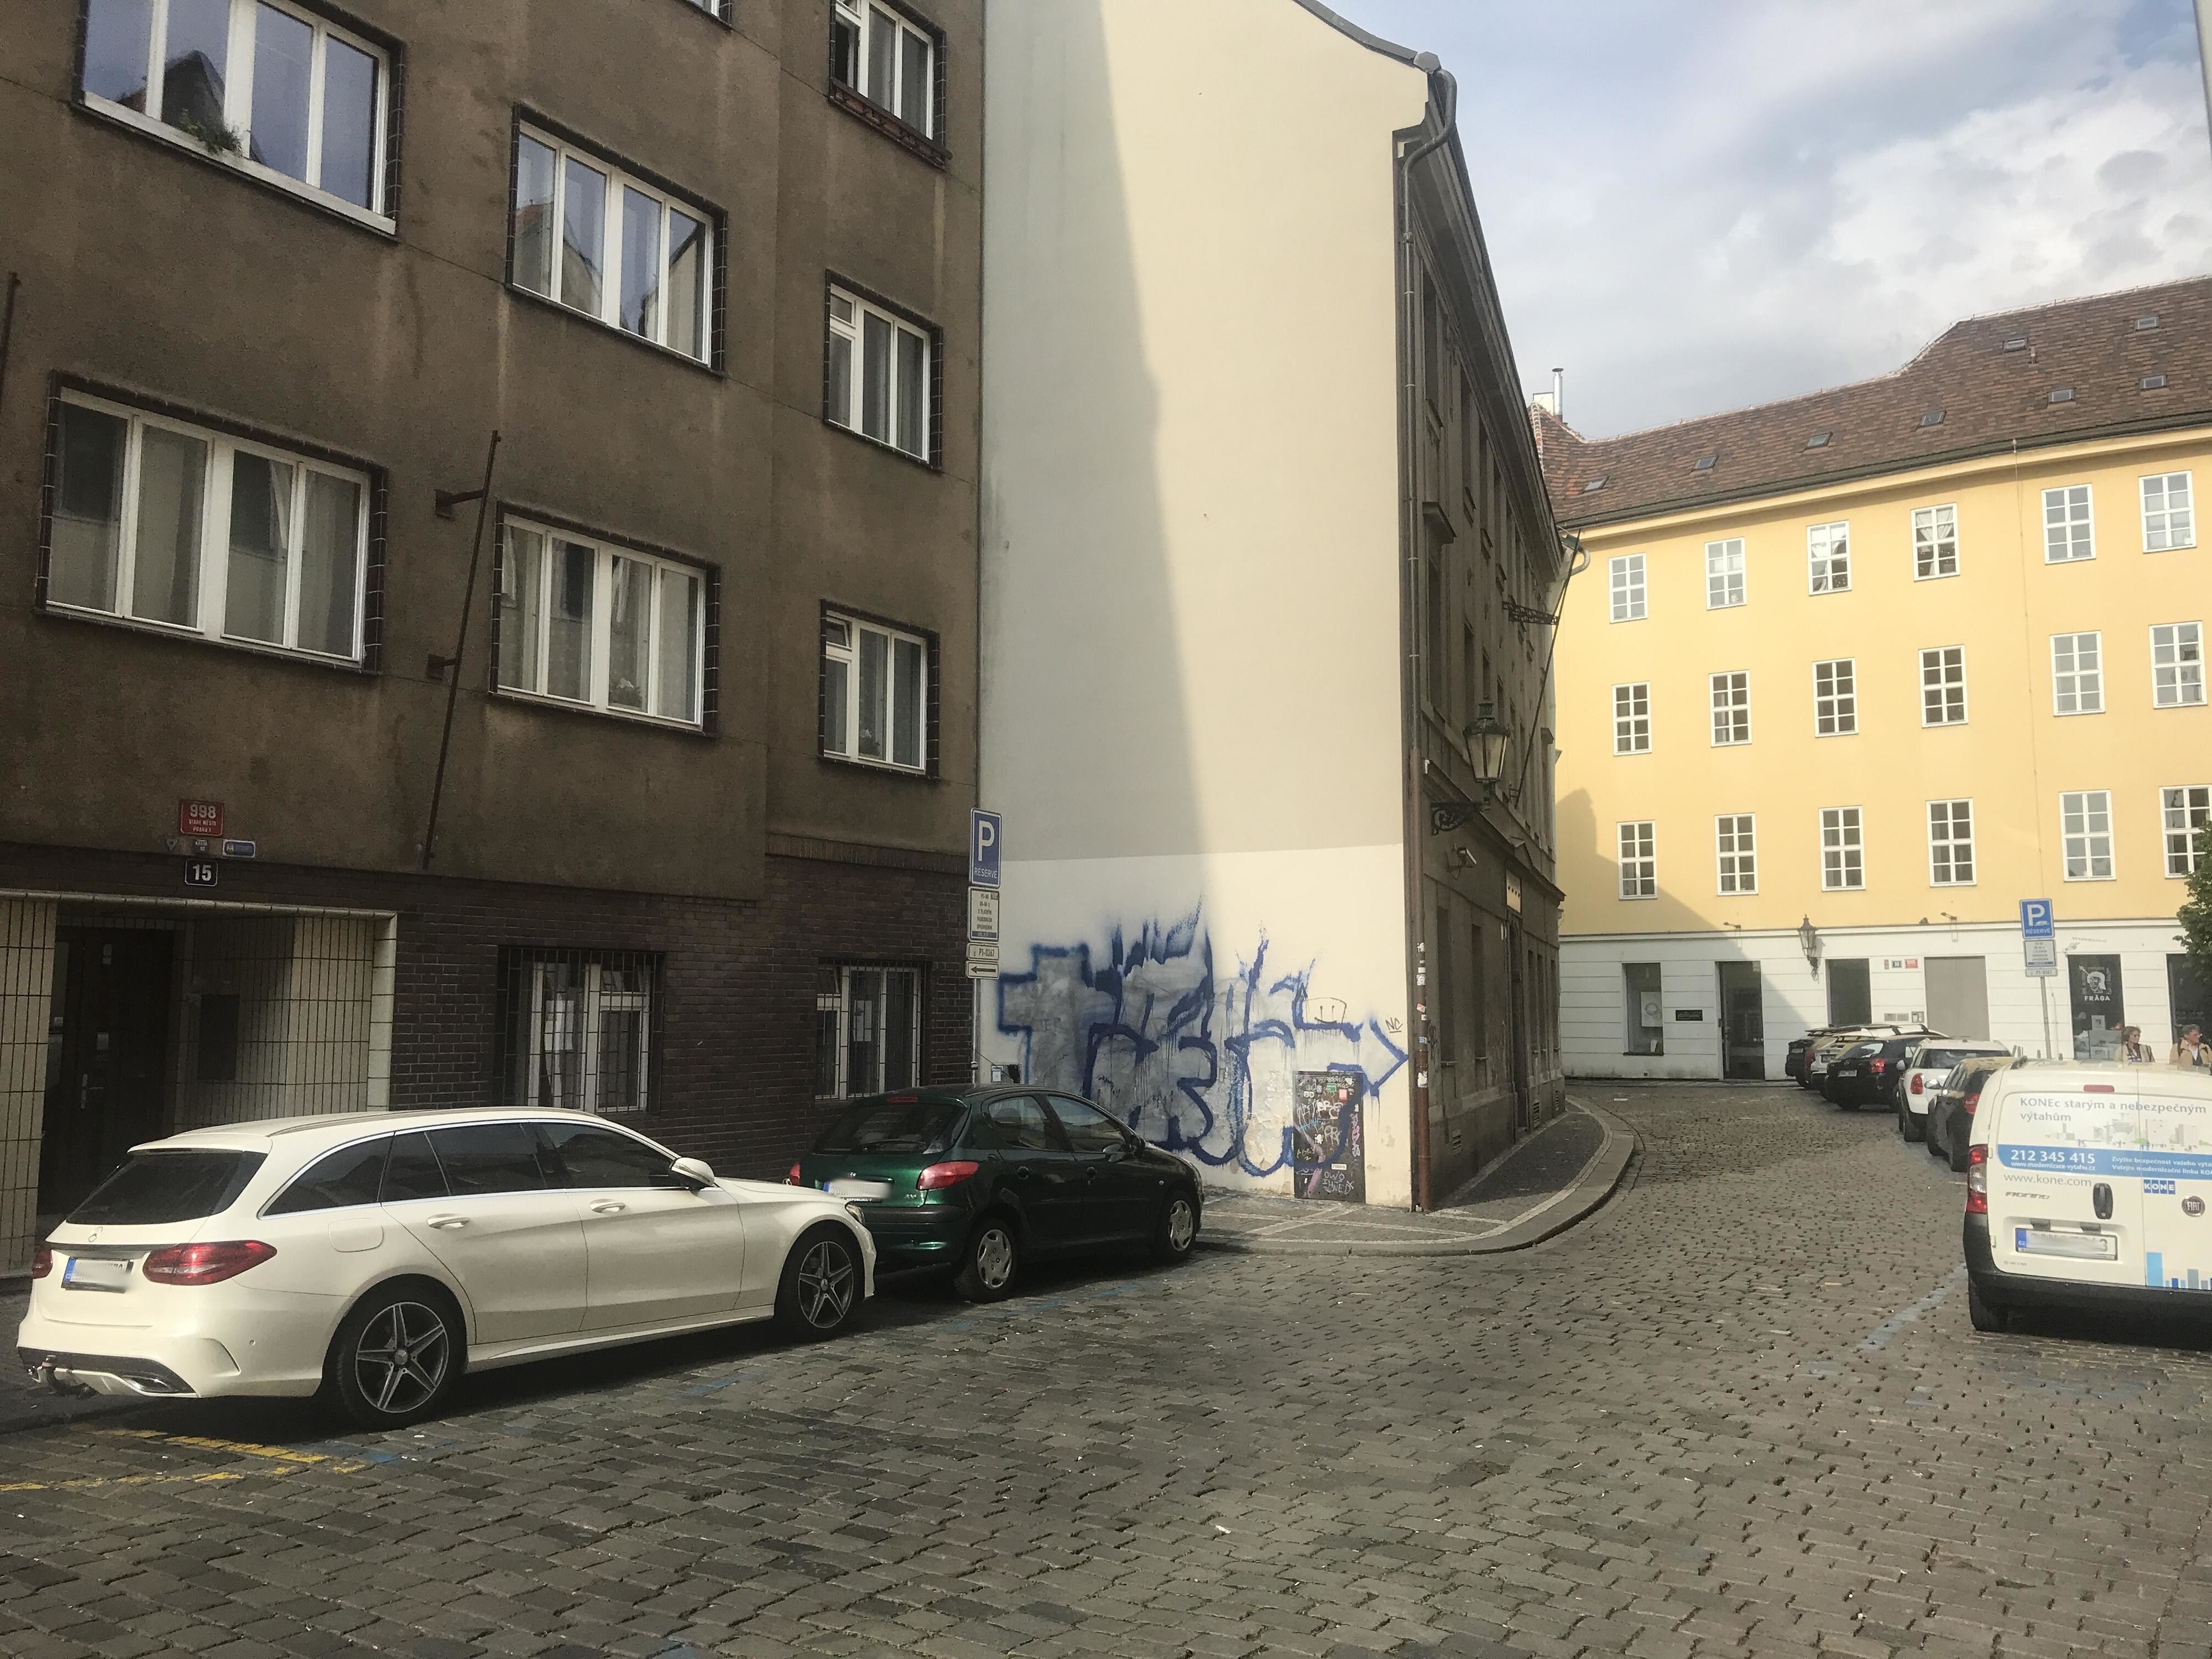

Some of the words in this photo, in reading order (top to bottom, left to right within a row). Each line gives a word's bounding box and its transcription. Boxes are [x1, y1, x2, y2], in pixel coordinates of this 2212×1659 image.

[190, 804, 216, 818] 998
[978, 820, 995, 861] P
[193, 864, 211, 881] 15
[2027, 904, 2045, 926] P
[2021, 1098, 2060, 1108] KONEc
[2064, 1099, 2105, 1111] starým
[2120, 1101, 2206, 1115] nebezpečným
[2021, 1112, 2072, 1123] výtahům
[2010, 1149, 2036, 1161] 212
[2039, 1151, 2065, 1162] 345
[2069, 1152, 2095, 1164] 415
[2010, 1161, 2096, 1171] www.modernizace-vytahu.cz
[2004, 1174, 2091, 1187] www.kone.com
[2144, 1183, 2175, 1191] KONE
[2187, 1201, 2200, 1211] FIAT
